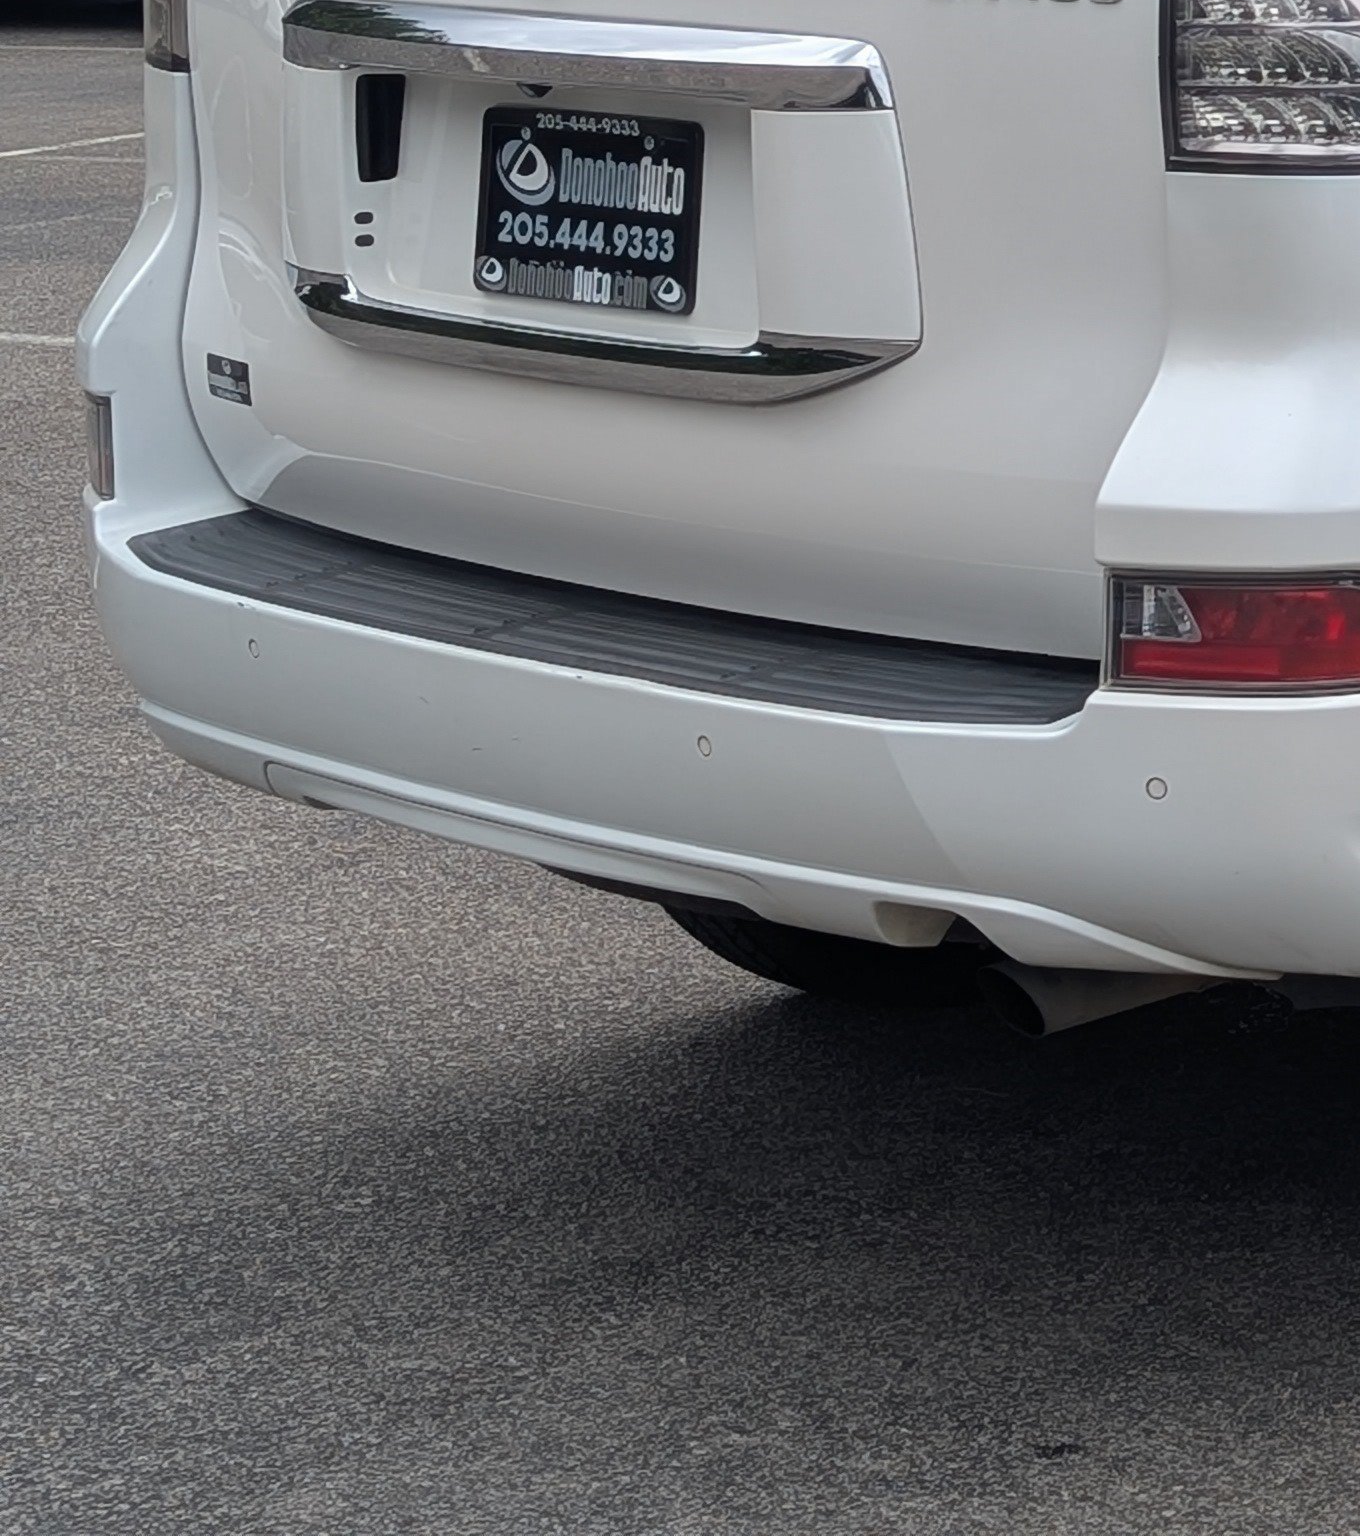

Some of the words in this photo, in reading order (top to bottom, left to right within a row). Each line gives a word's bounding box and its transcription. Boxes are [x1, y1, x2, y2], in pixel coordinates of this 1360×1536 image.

[536, 112, 640, 137] 205-444-9333
[558, 147, 685, 216] DonohooAuto
[497, 210, 675, 263] 205.444.9333
